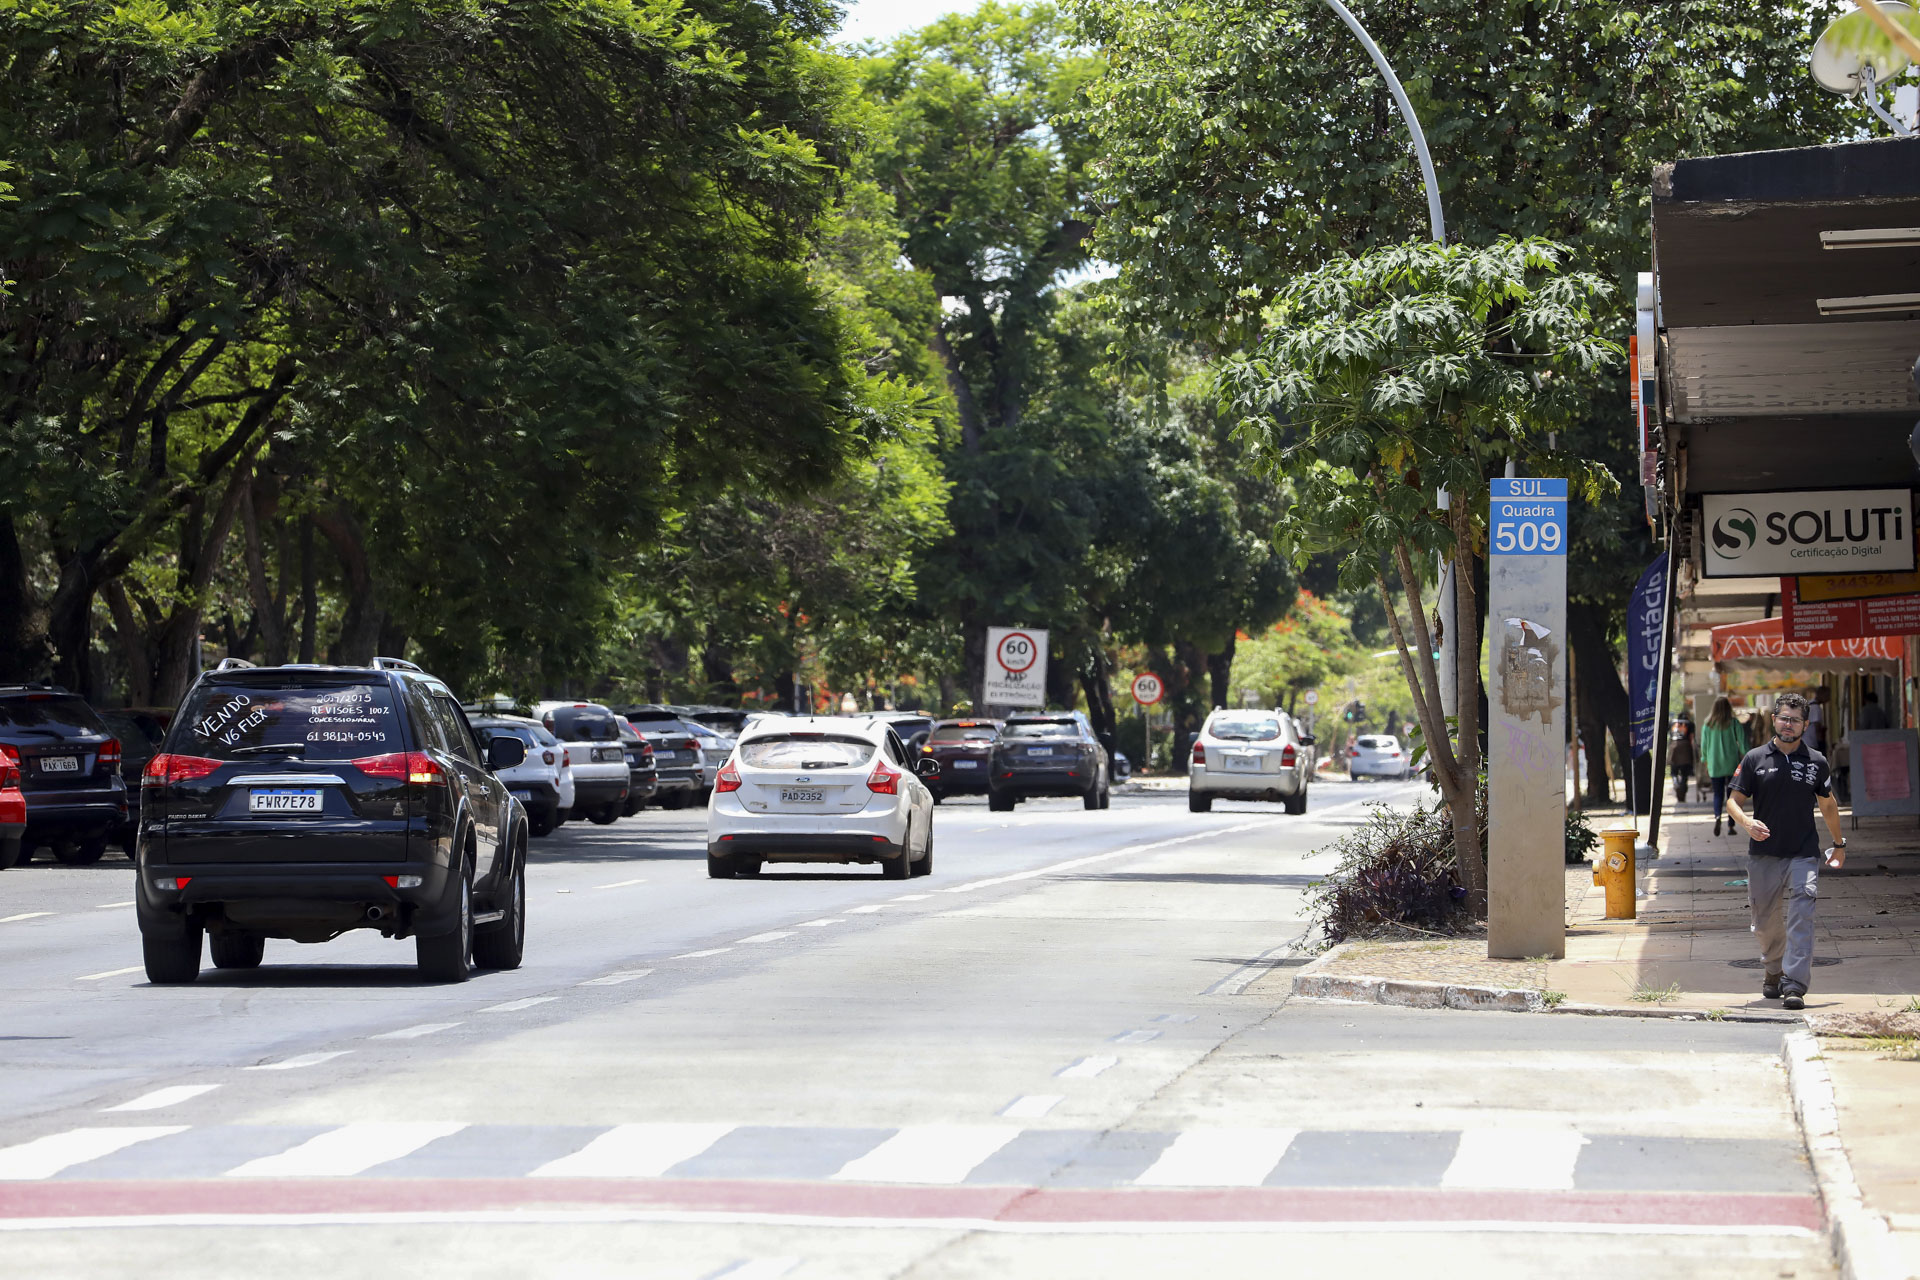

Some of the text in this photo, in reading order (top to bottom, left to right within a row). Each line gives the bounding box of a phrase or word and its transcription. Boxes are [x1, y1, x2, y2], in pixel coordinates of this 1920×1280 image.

[1509, 480, 1547, 496] SUL
[1502, 504, 1555, 517] Quadra
[1766, 507, 1902, 545] SOLUTi
[1496, 522, 1561, 551] 509
[1790, 545, 1882, 558] Certificação Digital
[1006, 641, 1028, 654] 60
[1138, 679, 1156, 692] 60
[194, 695, 250, 737] VENDO
[311, 705, 363, 715] REVISÕES
[309, 715, 376, 723] CONCESSIONÁRIA
[219, 708, 268, 745] V6 FLEX
[306, 732, 386, 742] 61 98124-0549
[257, 796, 315, 809] FWR7E78
